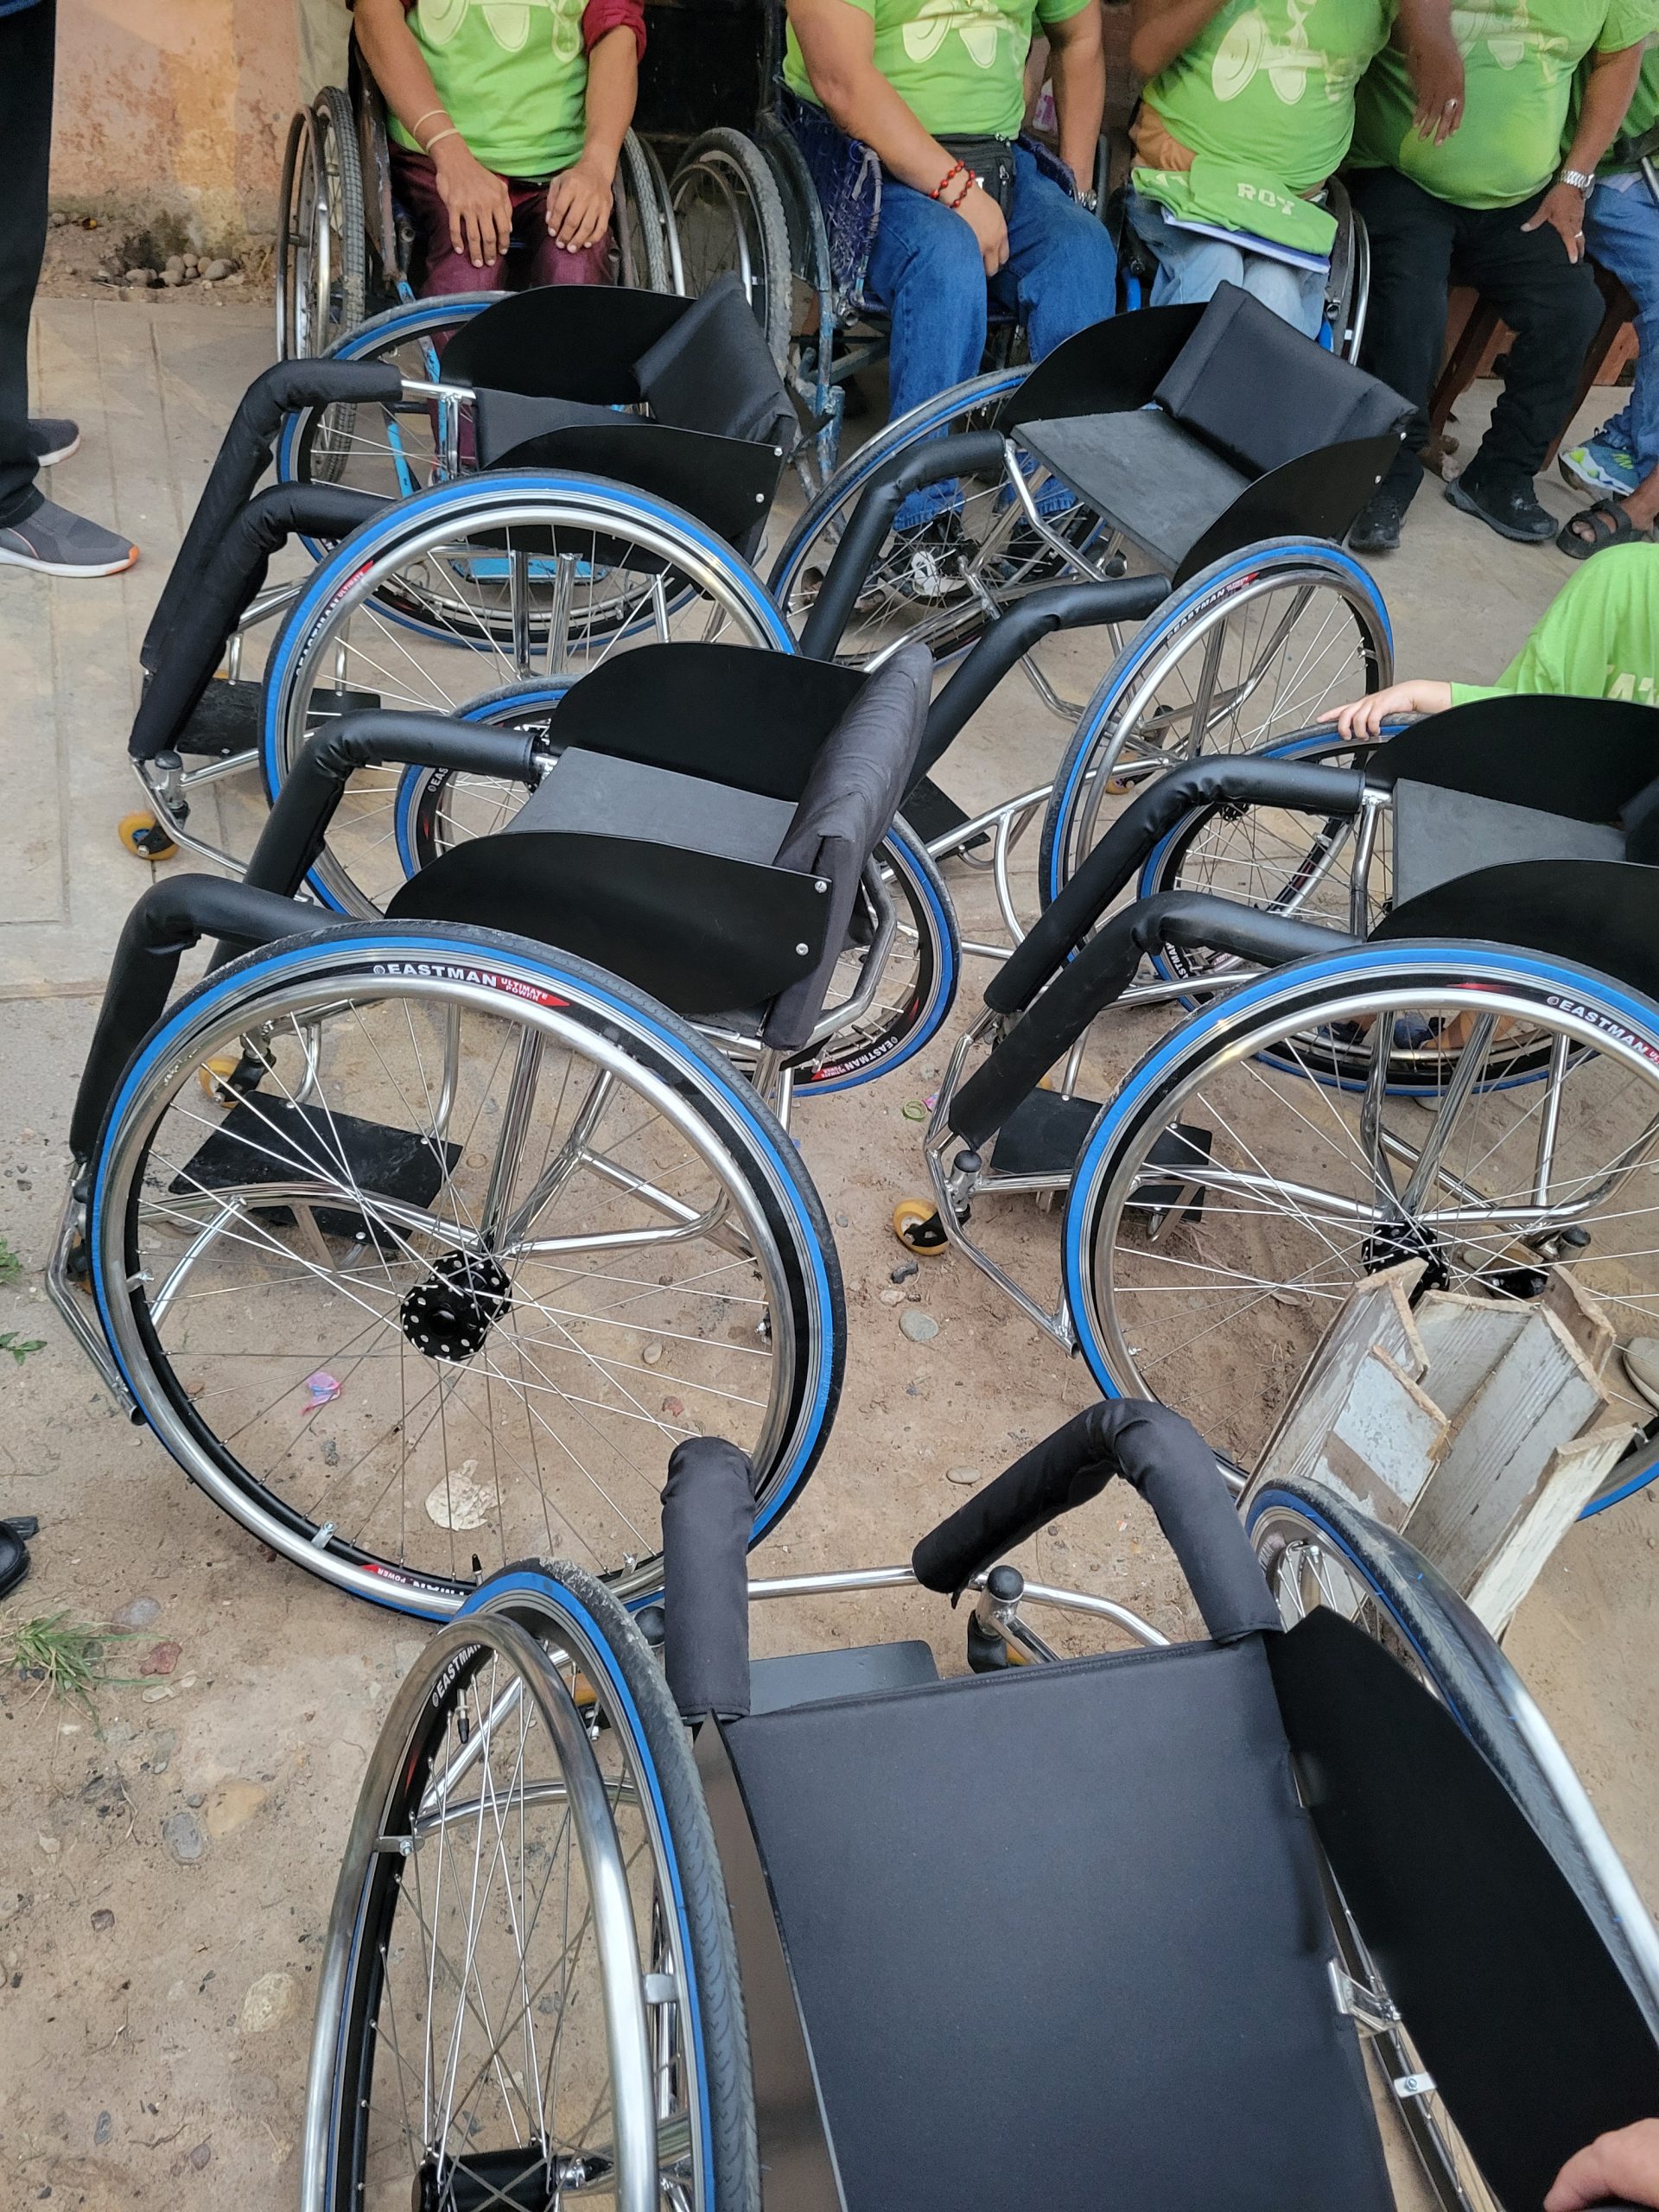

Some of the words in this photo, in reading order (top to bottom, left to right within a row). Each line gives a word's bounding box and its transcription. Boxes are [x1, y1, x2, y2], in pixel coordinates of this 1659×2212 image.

[1173, 588, 1225, 633] EASTMAN
[387, 963, 497, 988] EASTMAN
[500, 977, 549, 1001] ULTIMATE
[505, 984, 539, 1002] POWER
[1559, 999, 1649, 1054] EASTMAN
[844, 1039, 893, 1071] EASTMAN
[377, 1567, 407, 1584] POWER
